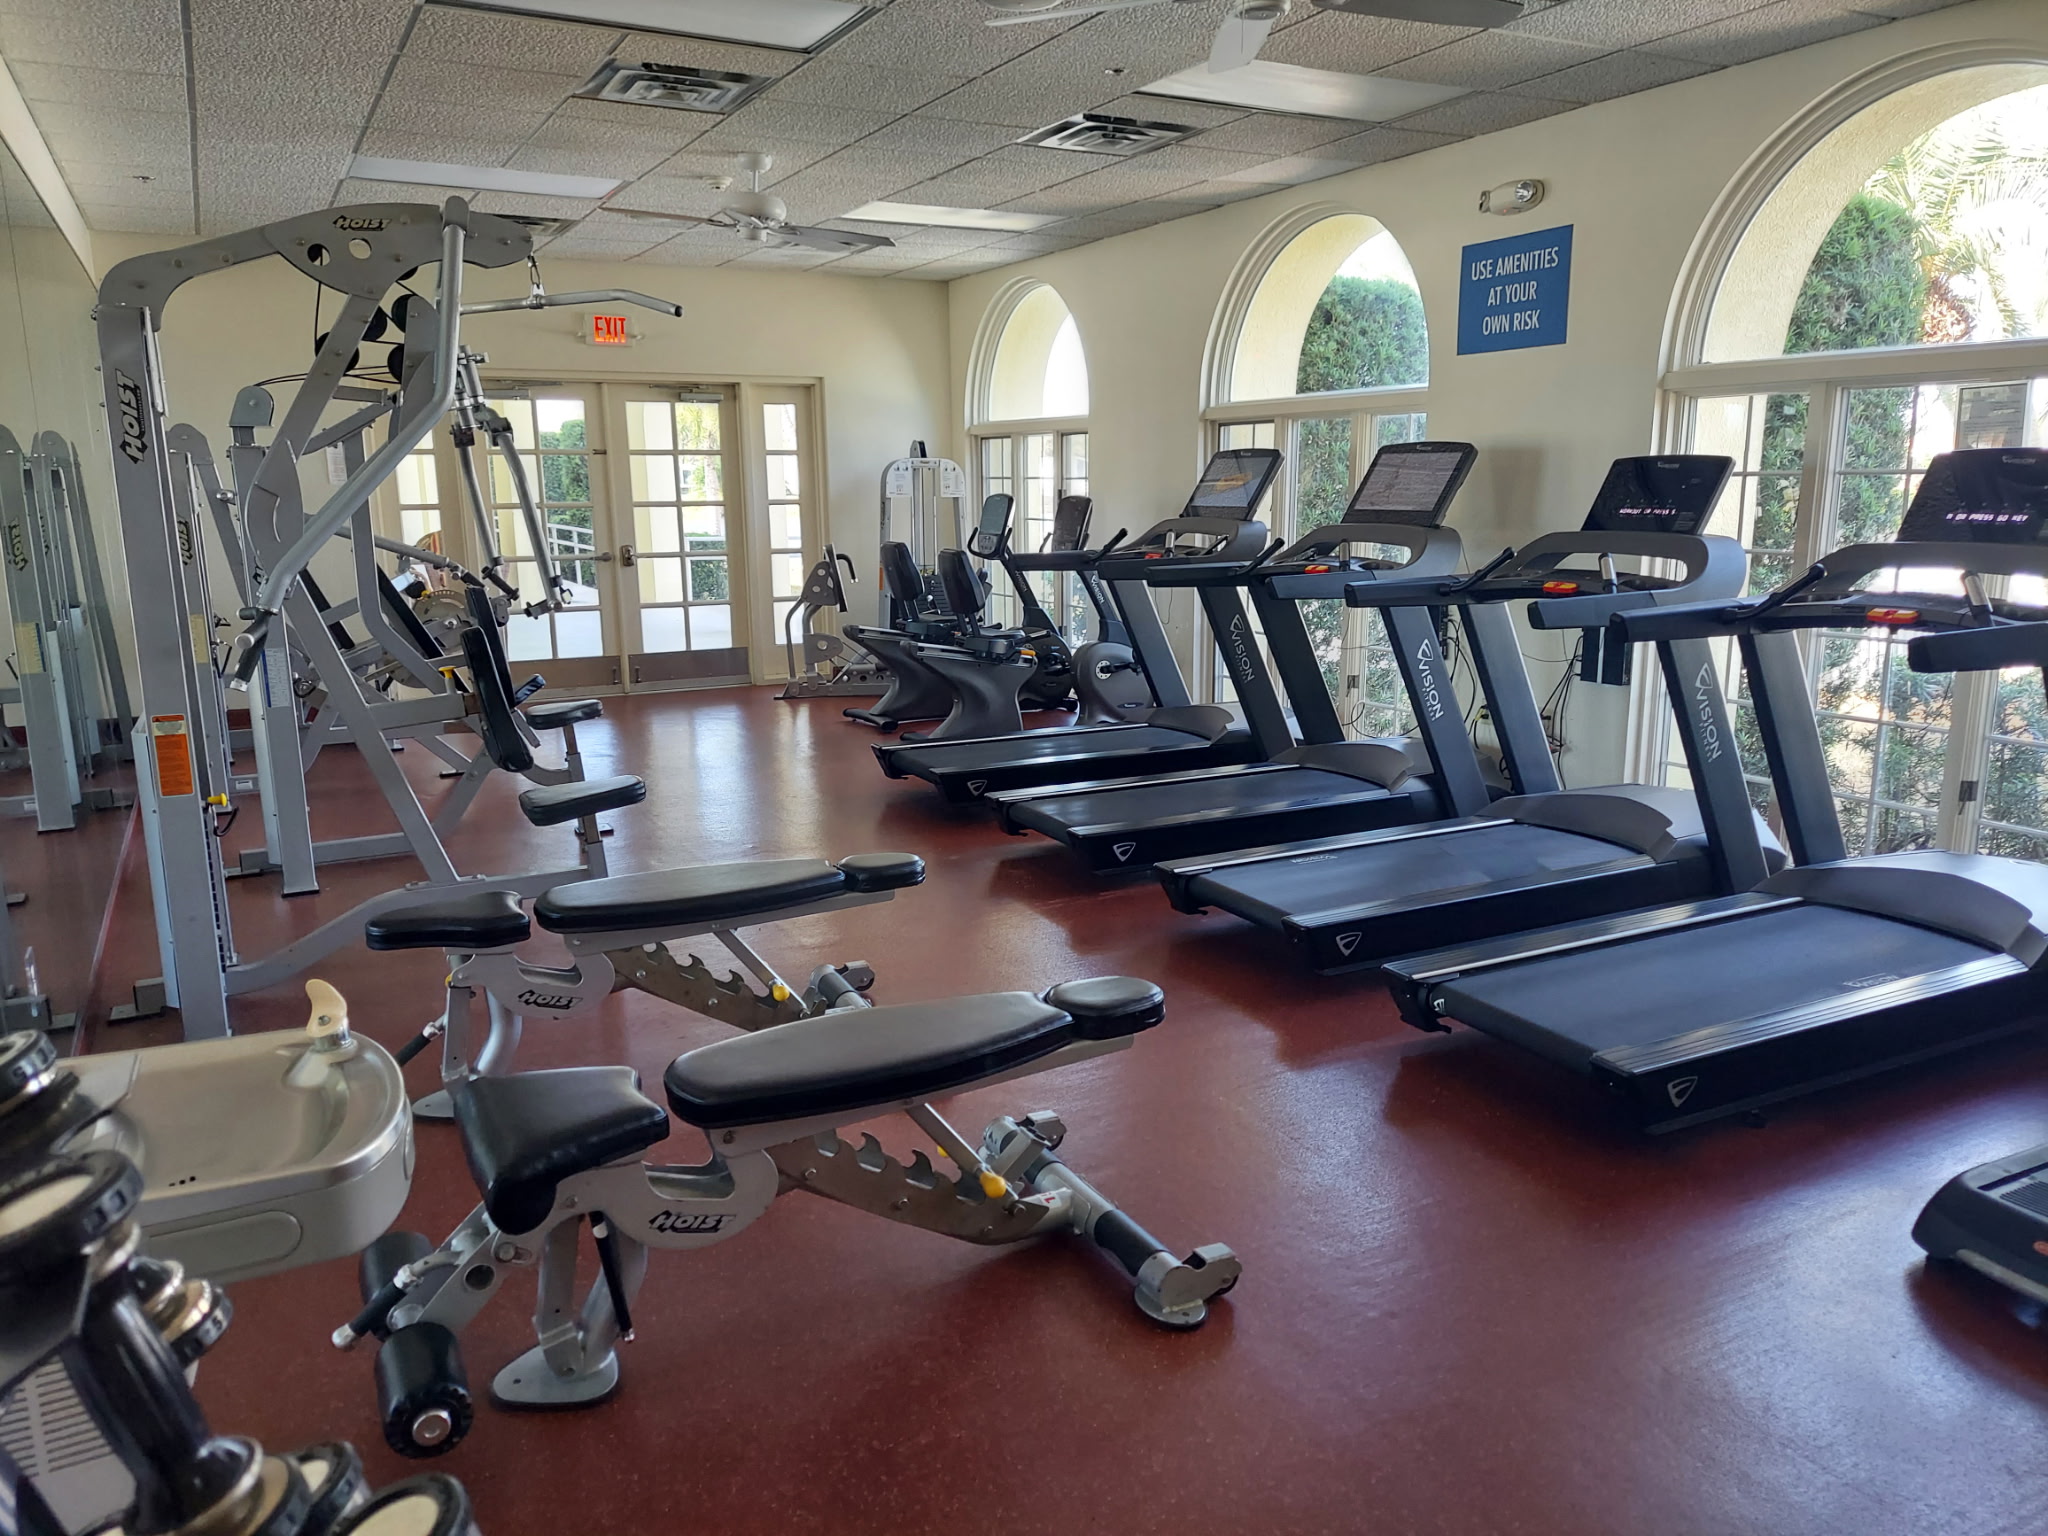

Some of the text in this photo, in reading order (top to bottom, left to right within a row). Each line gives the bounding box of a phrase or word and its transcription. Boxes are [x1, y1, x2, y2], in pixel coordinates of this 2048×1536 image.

[333, 216, 391, 231] HOIST
[1471, 246, 1559, 281] USE AMENITIES
[1487, 281, 1537, 307] AT YOUR
[594, 316, 626, 343] EXIT
[1482, 309, 1541, 335] OWN RISK
[115, 368, 147, 464] HOIST
[1231, 631, 1255, 681] VISION
[1418, 659, 1444, 719] VISION
[1696, 688, 1722, 760] VISION
[518, 990, 583, 1009] HOIST
[648, 1210, 736, 1233] HOIST
